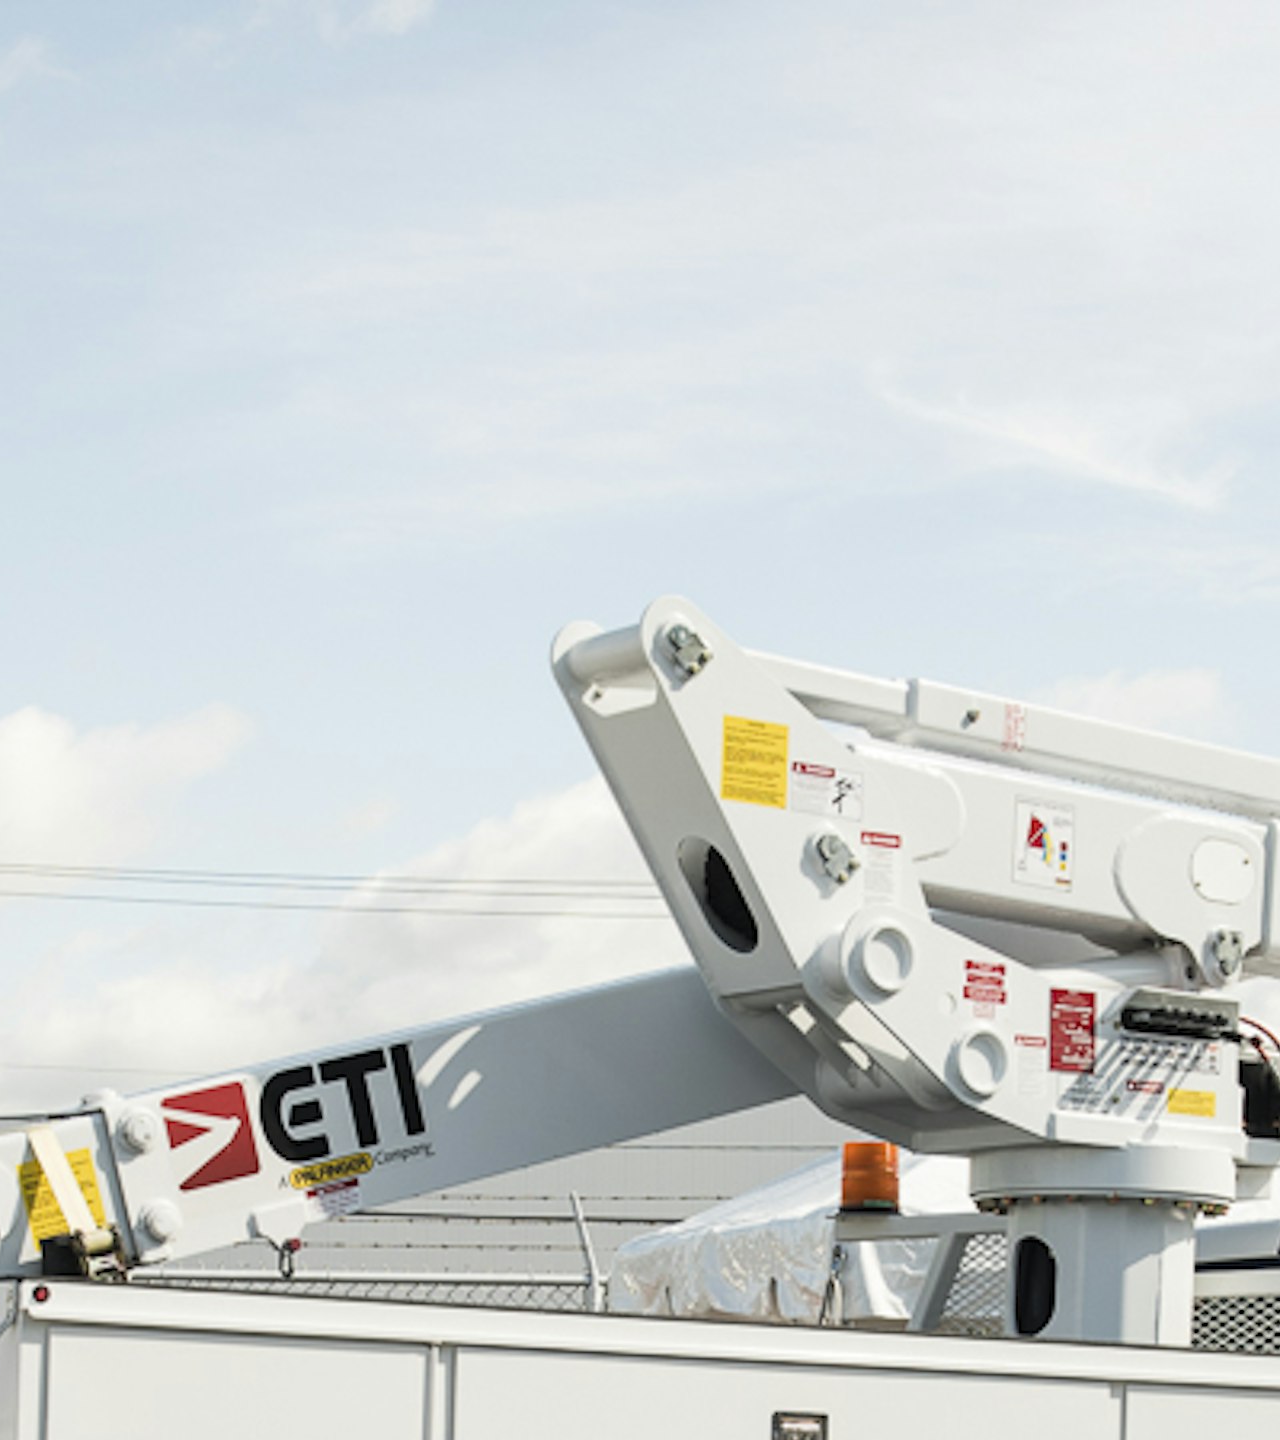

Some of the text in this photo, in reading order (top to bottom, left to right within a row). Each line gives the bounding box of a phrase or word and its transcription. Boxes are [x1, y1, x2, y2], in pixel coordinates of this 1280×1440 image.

[260, 1043, 425, 1163] ETI
[293, 1155, 370, 1185] PALFINGER
[374, 1142, 436, 1166] Company
